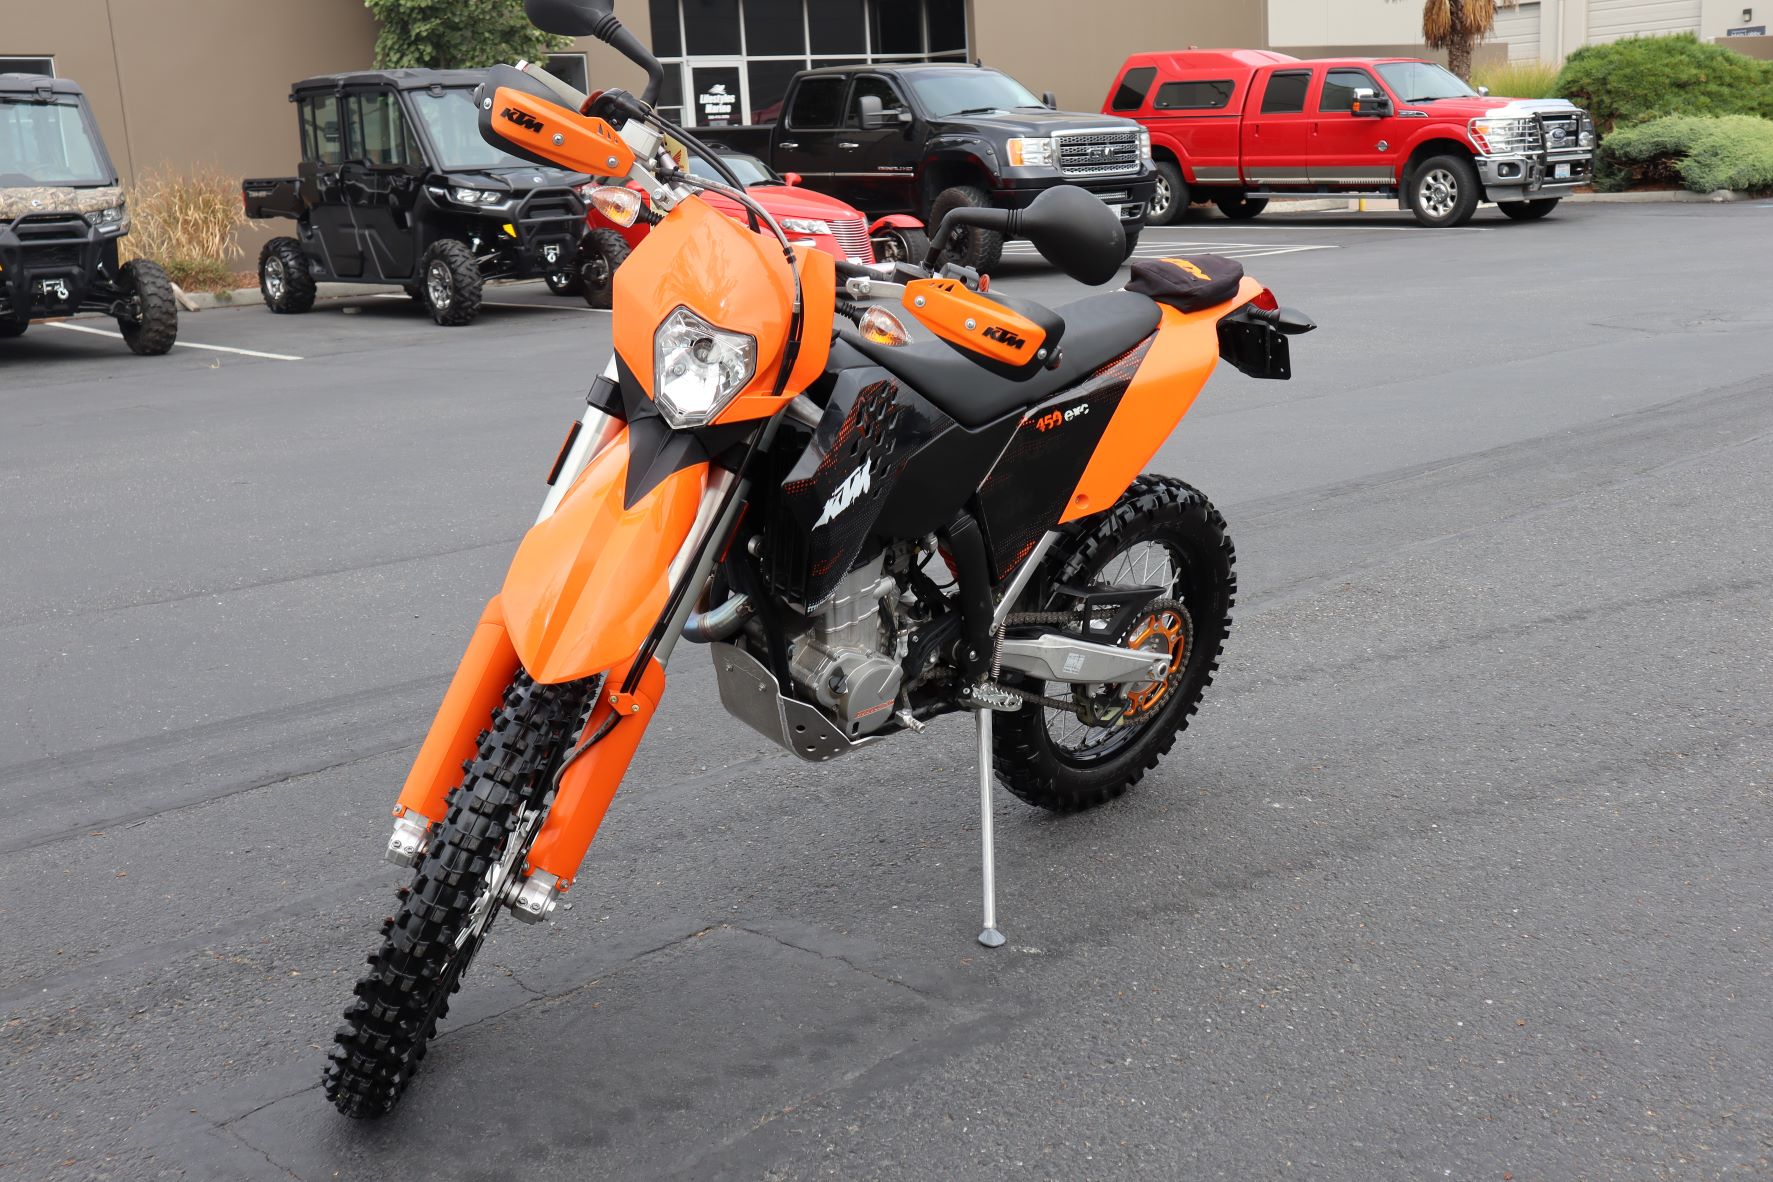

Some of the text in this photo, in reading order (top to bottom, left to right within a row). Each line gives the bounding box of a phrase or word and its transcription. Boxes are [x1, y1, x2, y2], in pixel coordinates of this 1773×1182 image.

[500, 107, 545, 134] KTM
[1087, 147, 1121, 160] GMC
[982, 326, 1025, 350] KTM
[811, 456, 871, 531] KTM
